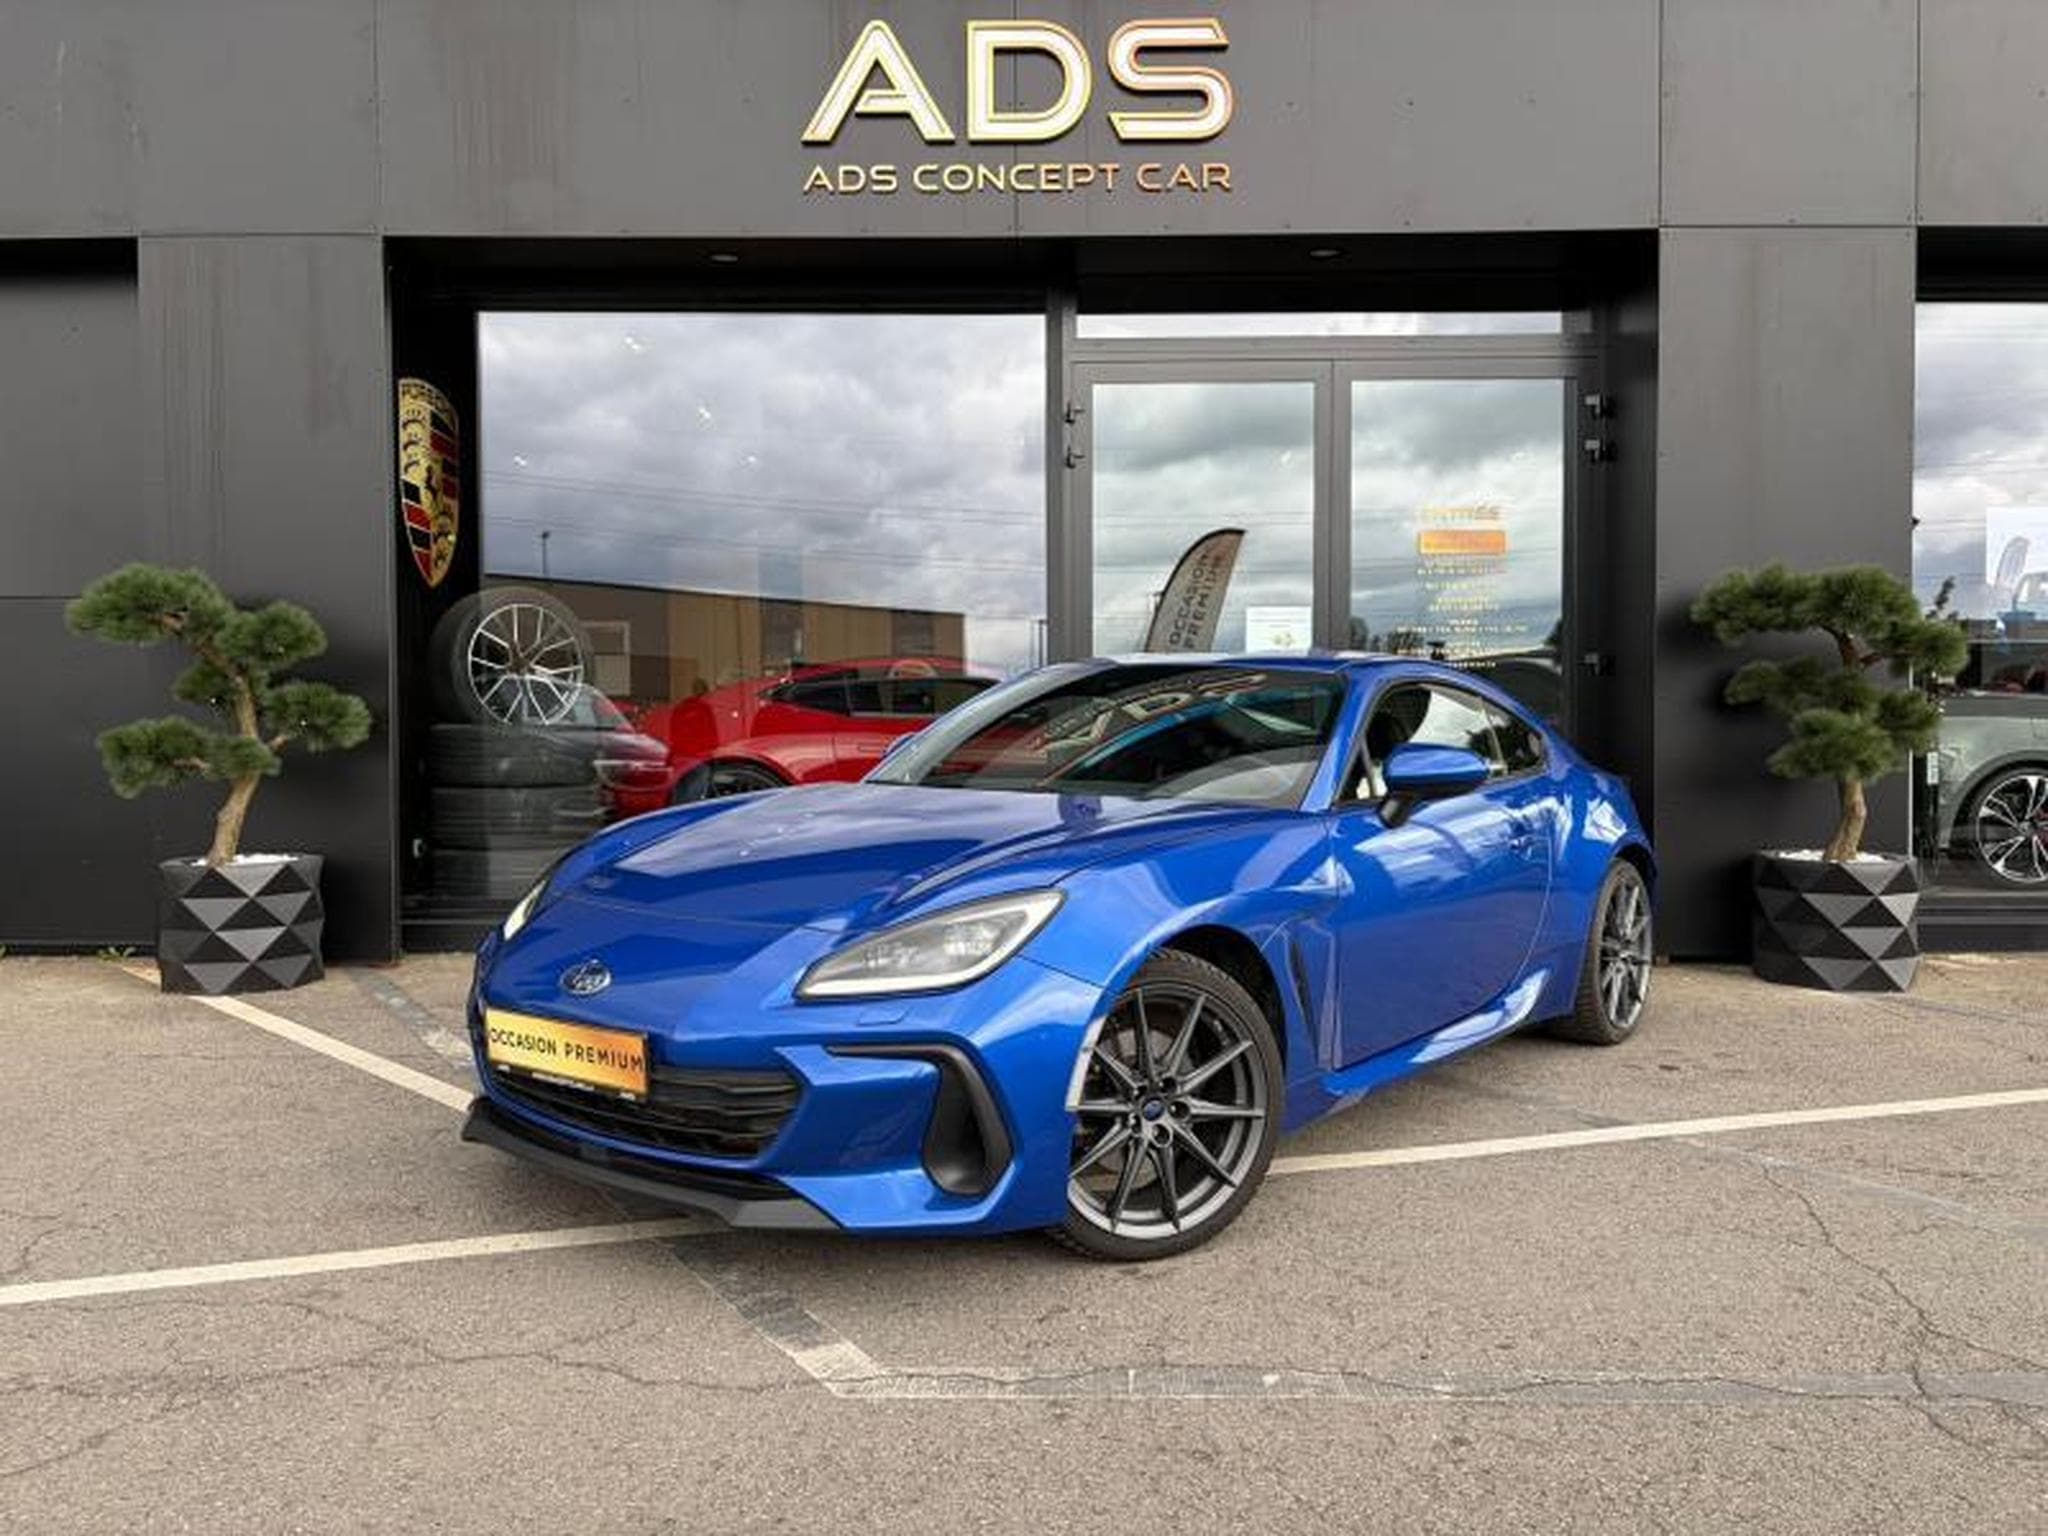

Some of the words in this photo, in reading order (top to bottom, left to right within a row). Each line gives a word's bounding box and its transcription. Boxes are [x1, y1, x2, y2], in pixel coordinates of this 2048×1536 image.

[801, 18, 1233, 143] ADS
[803, 164, 899, 193] ADS
[913, 163, 1121, 193] CONCEPT
[1135, 163, 1233, 191] CAR
[490, 1028, 557, 1056] OCCASION
[564, 1043, 643, 1071] PREMIUM
